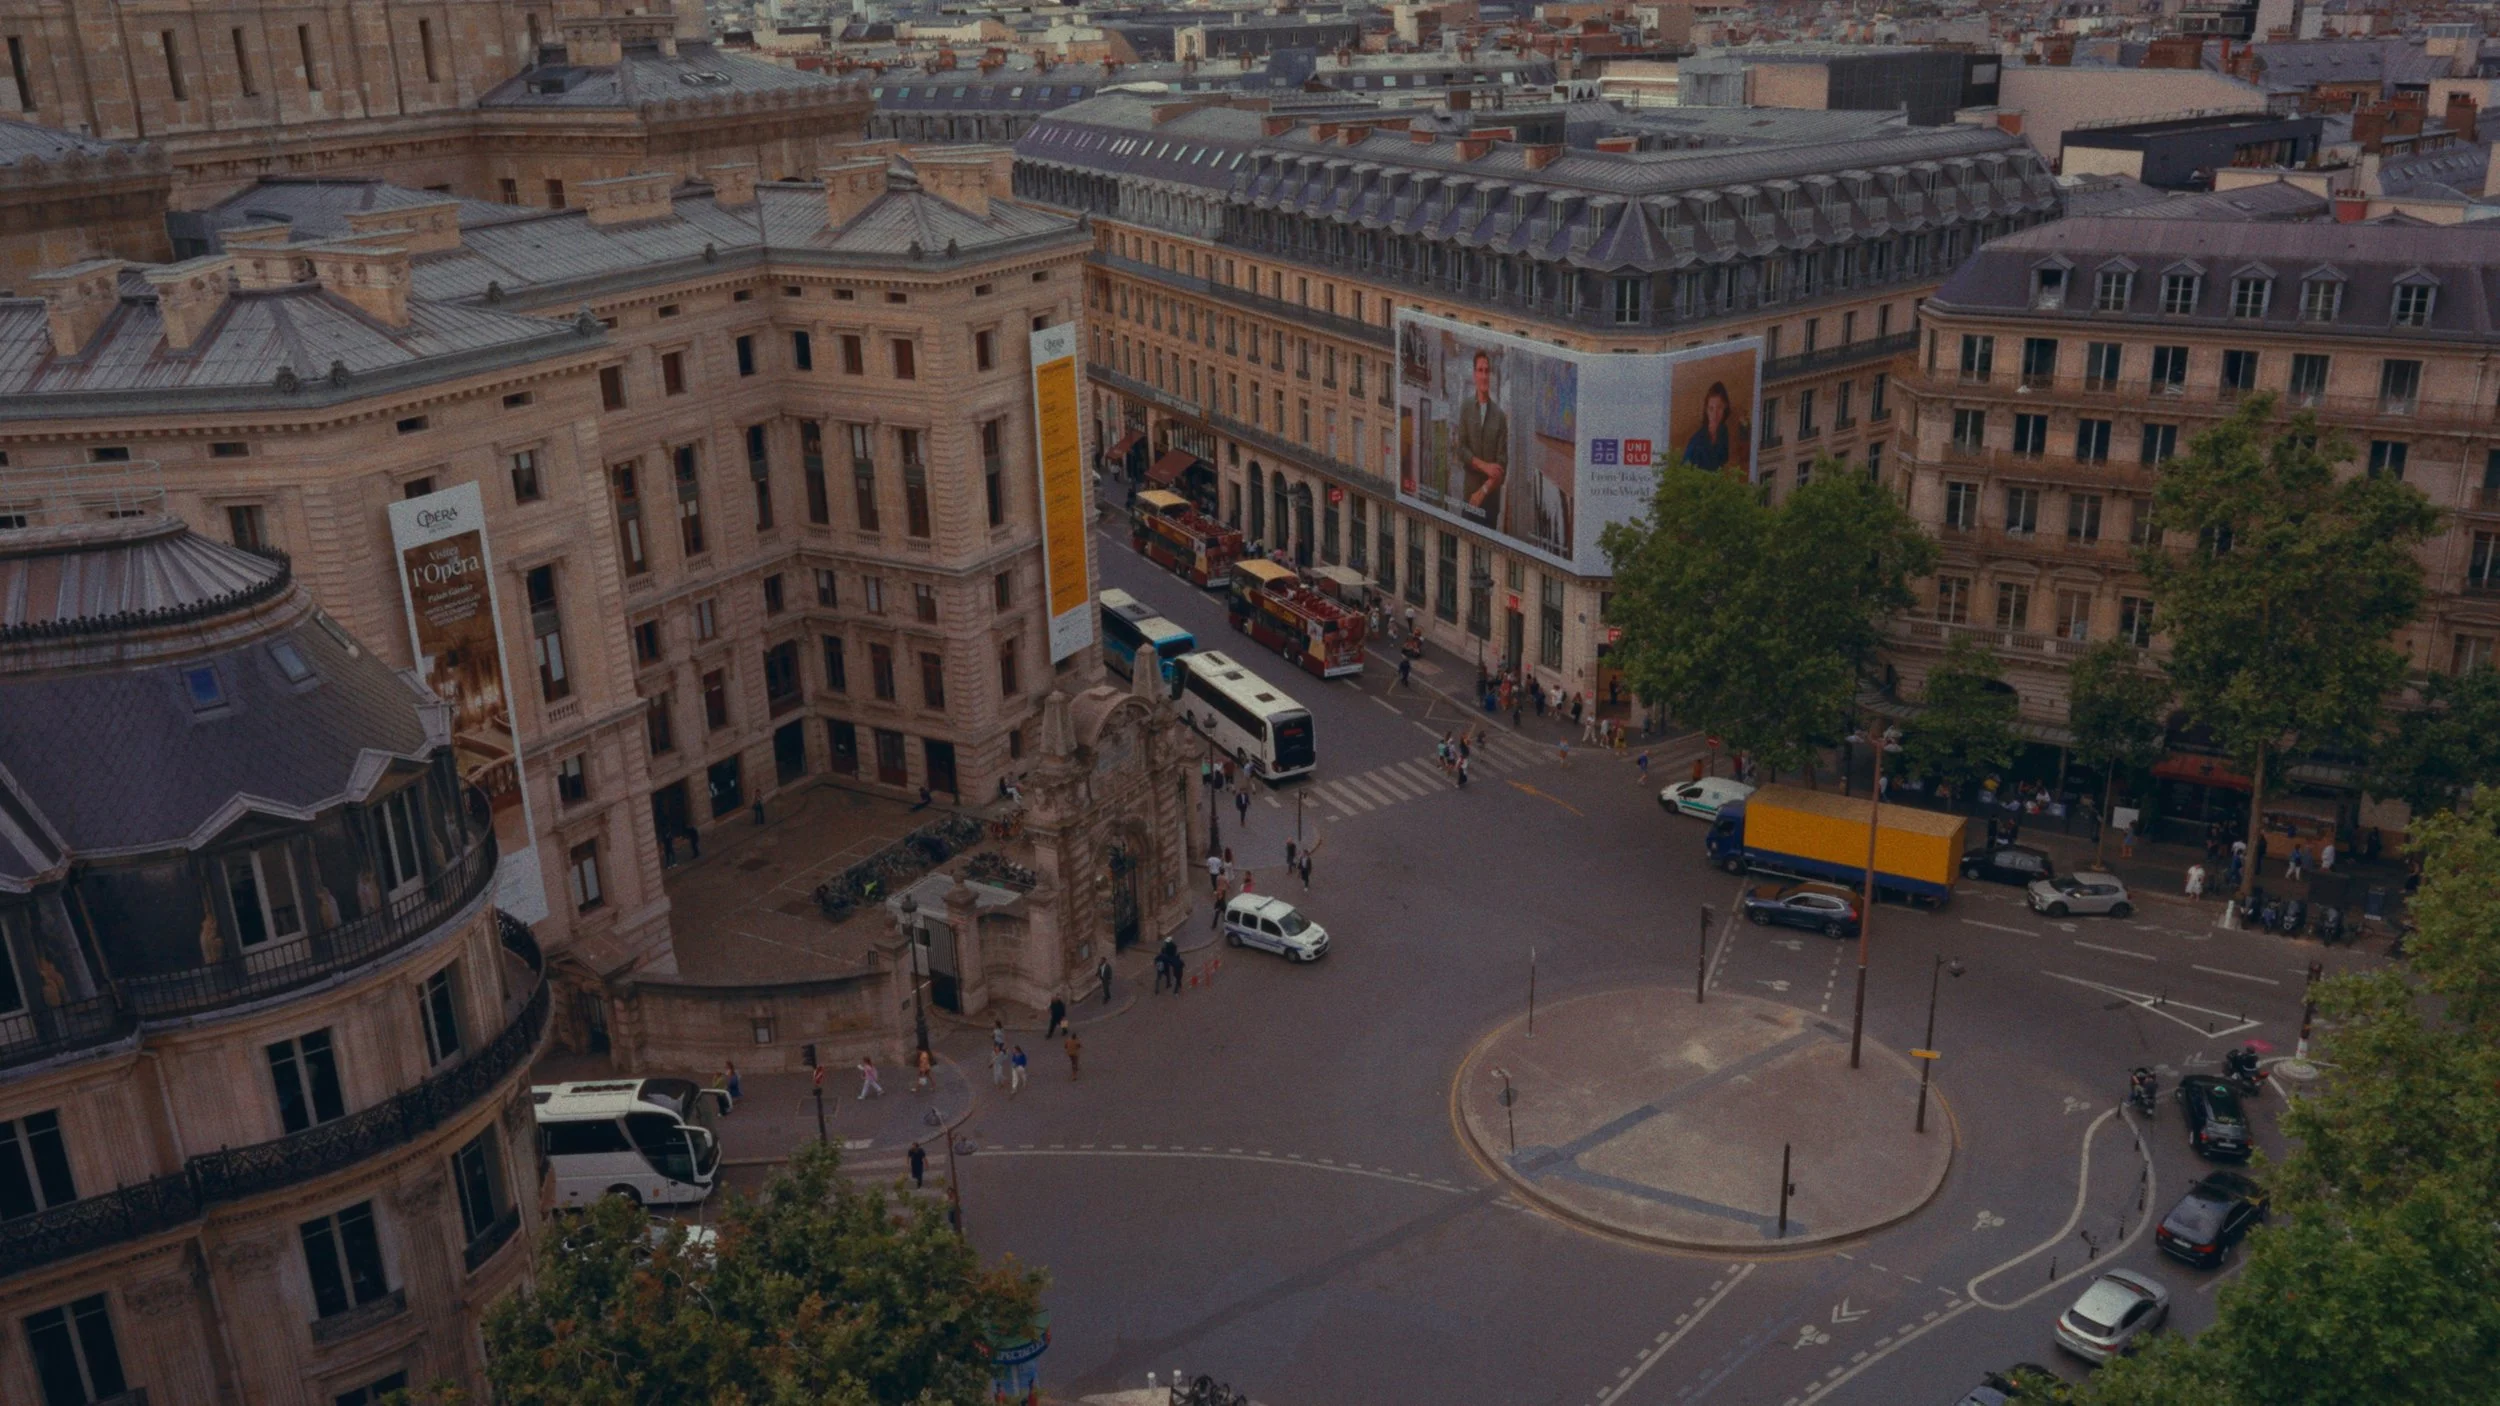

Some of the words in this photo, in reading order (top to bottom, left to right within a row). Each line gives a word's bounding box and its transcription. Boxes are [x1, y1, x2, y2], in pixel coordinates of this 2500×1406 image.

[1627, 442, 1647, 452] UNI
[1626, 452, 1648, 463] QLO
[1591, 471, 1617, 481] From
[1618, 486, 1650, 497] World
[428, 546, 459, 560] Visitez
[412, 555, 480, 587] l'Opéra
